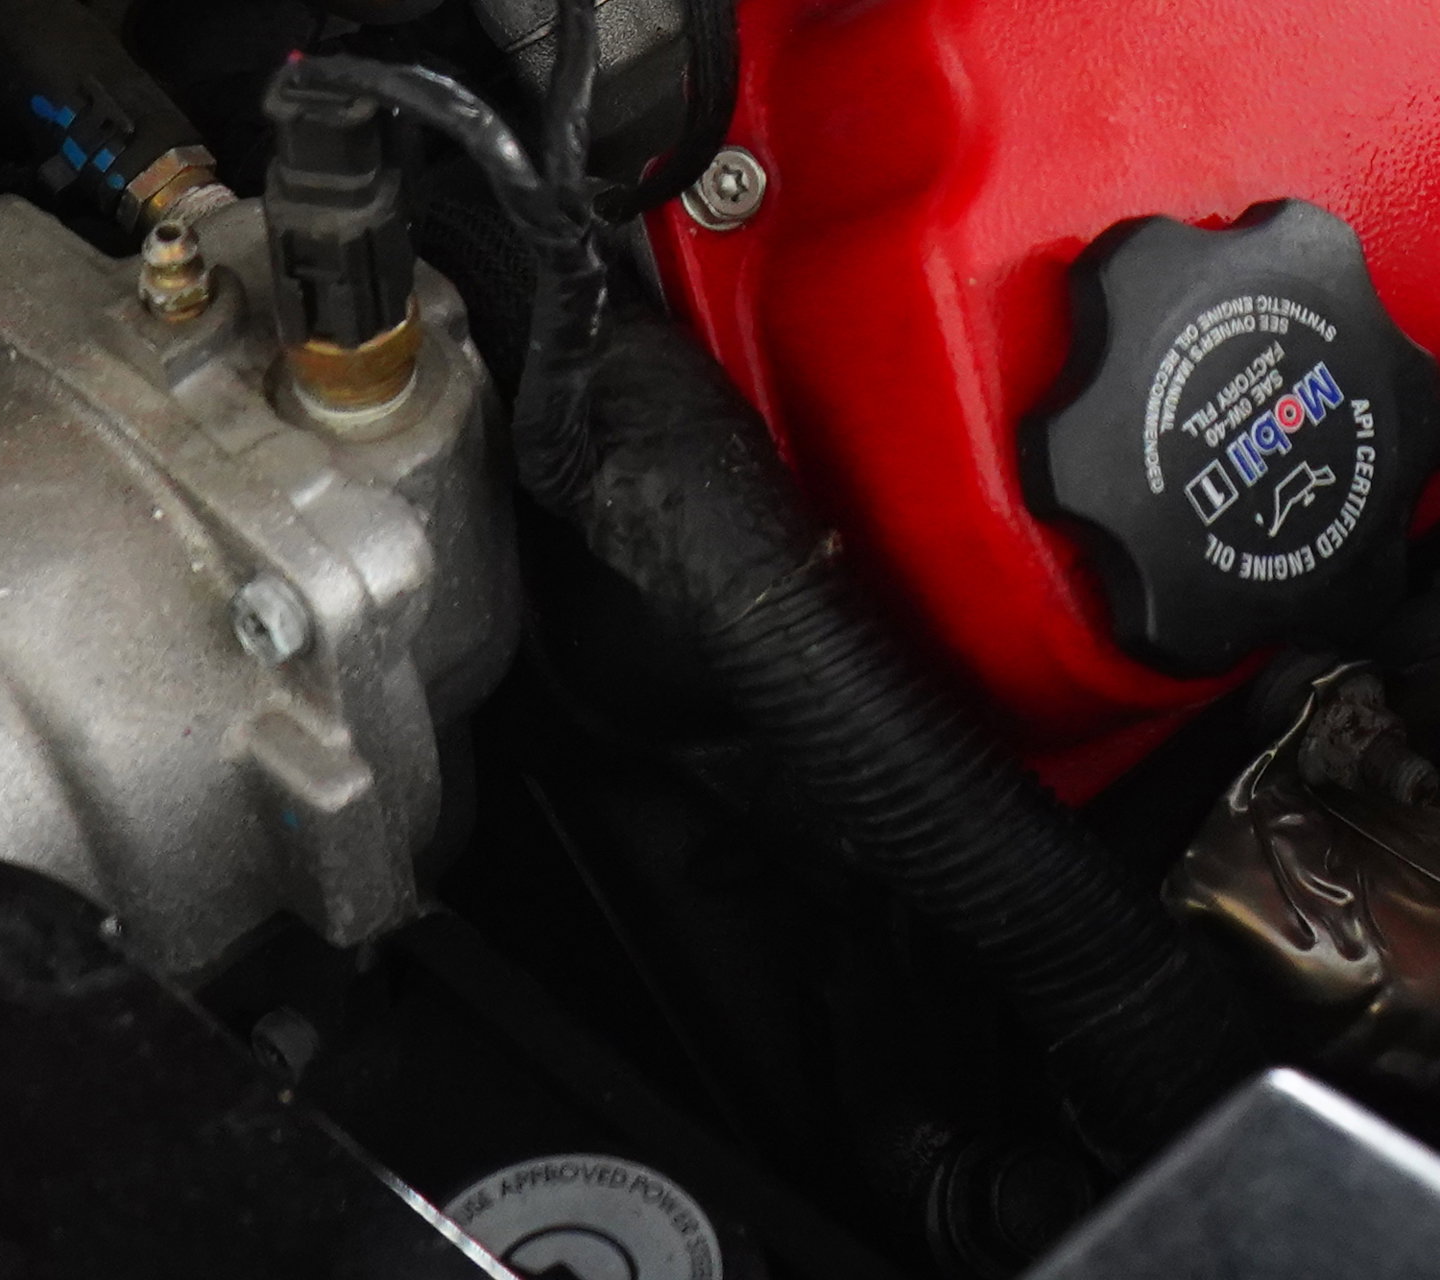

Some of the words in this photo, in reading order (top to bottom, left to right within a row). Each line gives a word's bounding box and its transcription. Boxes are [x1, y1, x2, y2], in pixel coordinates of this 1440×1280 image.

[1196, 296, 1253, 330] ENGINE
[1257, 294, 1337, 342] SYNTHETIC
[1259, 314, 1290, 335] SEE
[1174, 324, 1199, 350] OIL
[1188, 314, 1255, 363] OWNER'S
[1159, 357, 1195, 433] MANUAL
[1215, 340, 1286, 411] FACTORY
[1251, 369, 1284, 406] SAE
[1143, 348, 1180, 494] RECOMMENDED
[1181, 401, 1219, 438] FILL
[1204, 397, 1253, 448] 0W-40
[1225, 360, 1345, 488] Mobil
[1350, 399, 1375, 438] API
[1315, 446, 1376, 558] CERTIFIED
[1204, 532, 1236, 572] OIL
[1239, 545, 1316, 582] ENGINE
[500, 1162, 627, 1197] APPROVED
